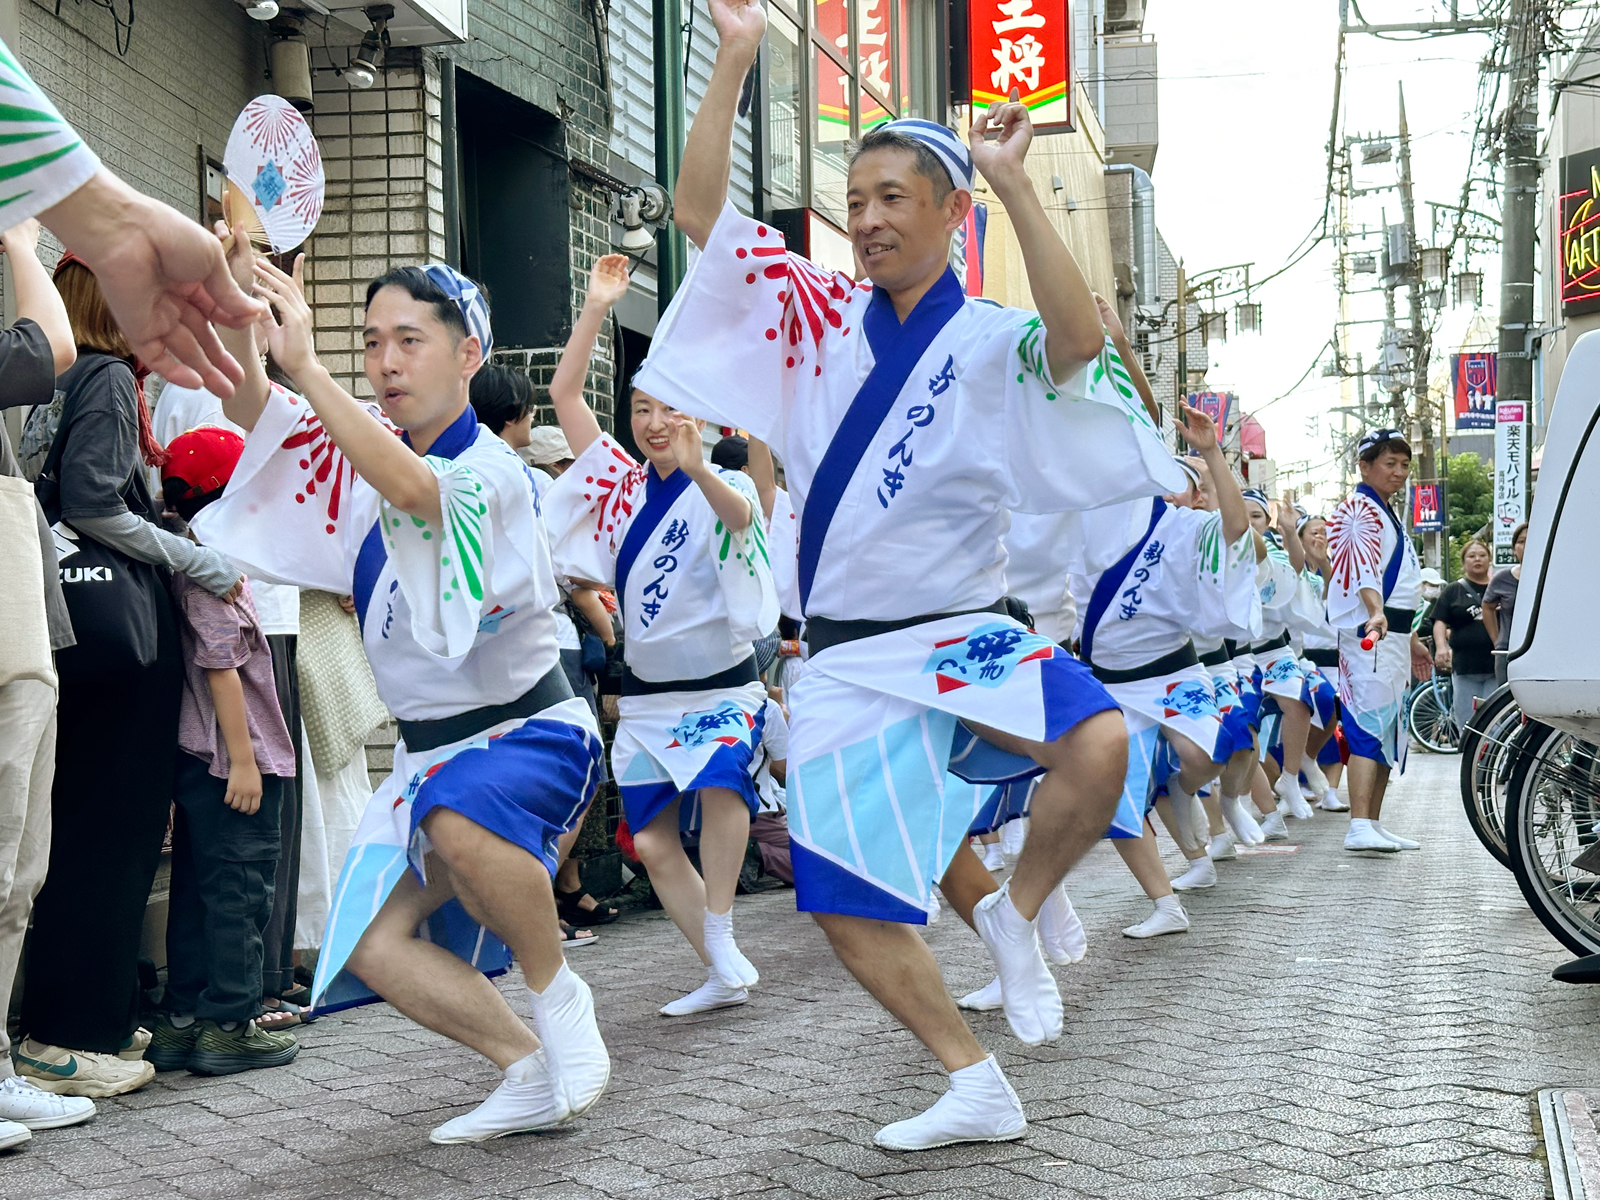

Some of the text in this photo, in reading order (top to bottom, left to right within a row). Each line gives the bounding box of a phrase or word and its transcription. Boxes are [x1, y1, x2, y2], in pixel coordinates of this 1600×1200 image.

[1507, 425, 1520, 499] 楽天モバイル
[640, 518, 690, 628] 新のんき
